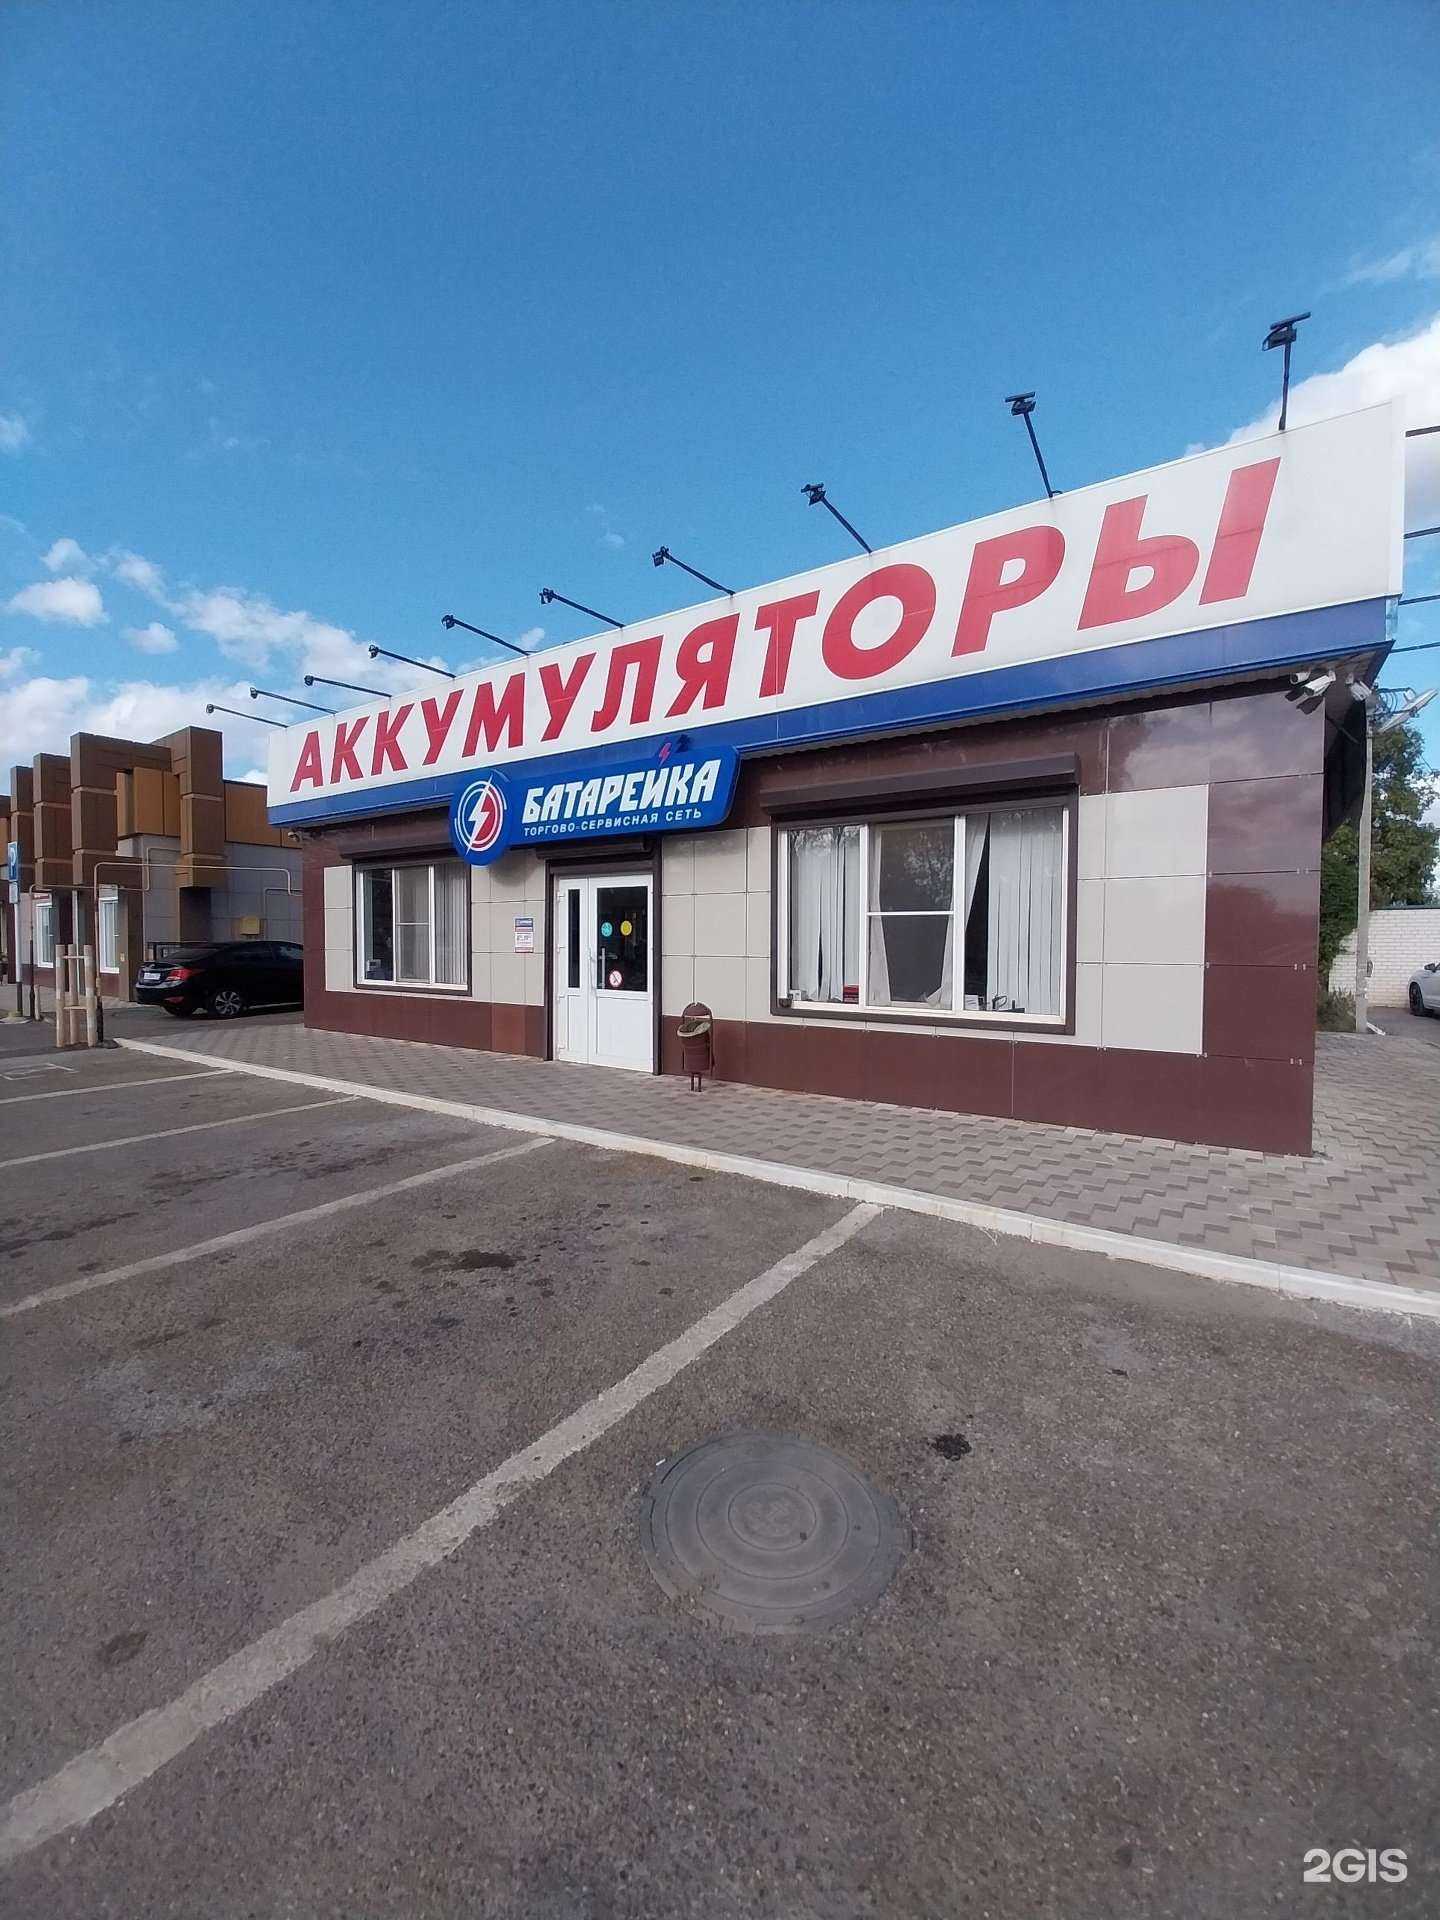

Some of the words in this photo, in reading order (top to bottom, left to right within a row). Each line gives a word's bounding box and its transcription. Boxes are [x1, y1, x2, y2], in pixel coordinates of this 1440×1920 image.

[290, 458, 1280, 791] АККУМУЛЯТОРЫ
[522, 743, 722, 823] БАТАРЕЙКА
[524, 813, 658, 837] ТОРГОВО-СЕРВИСНАЯ
[666, 808, 702, 822] СЕТЬ
